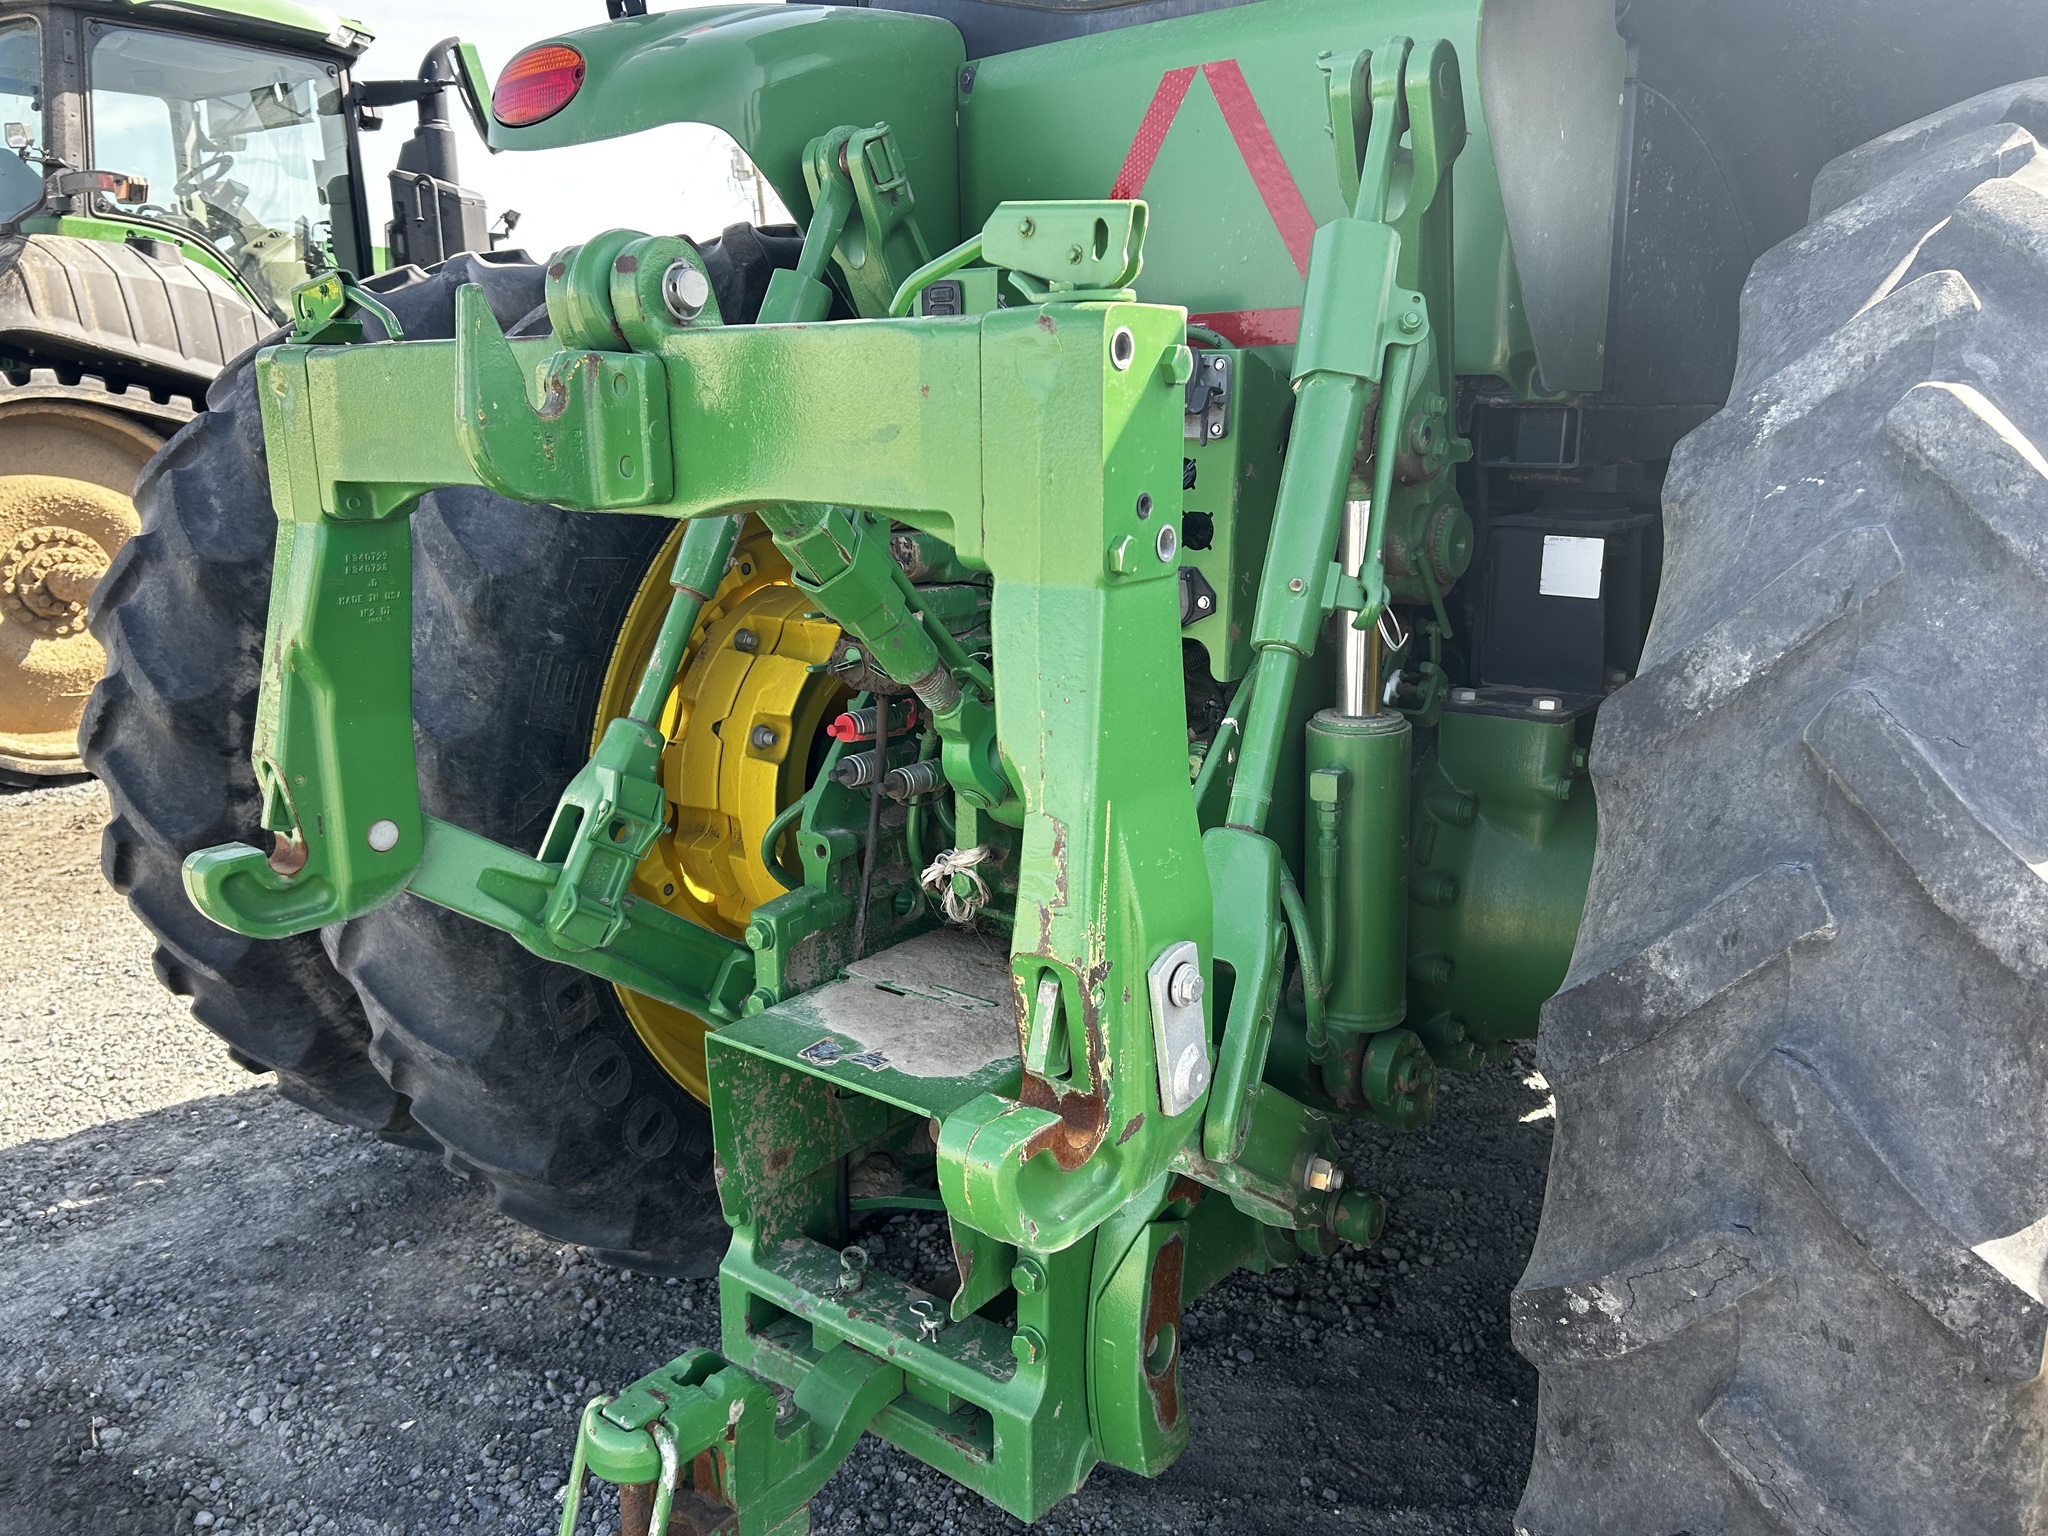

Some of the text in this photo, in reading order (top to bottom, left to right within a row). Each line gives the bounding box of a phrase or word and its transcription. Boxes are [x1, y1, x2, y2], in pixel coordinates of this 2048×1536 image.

[338, 591, 401, 606] MADE IN USA
